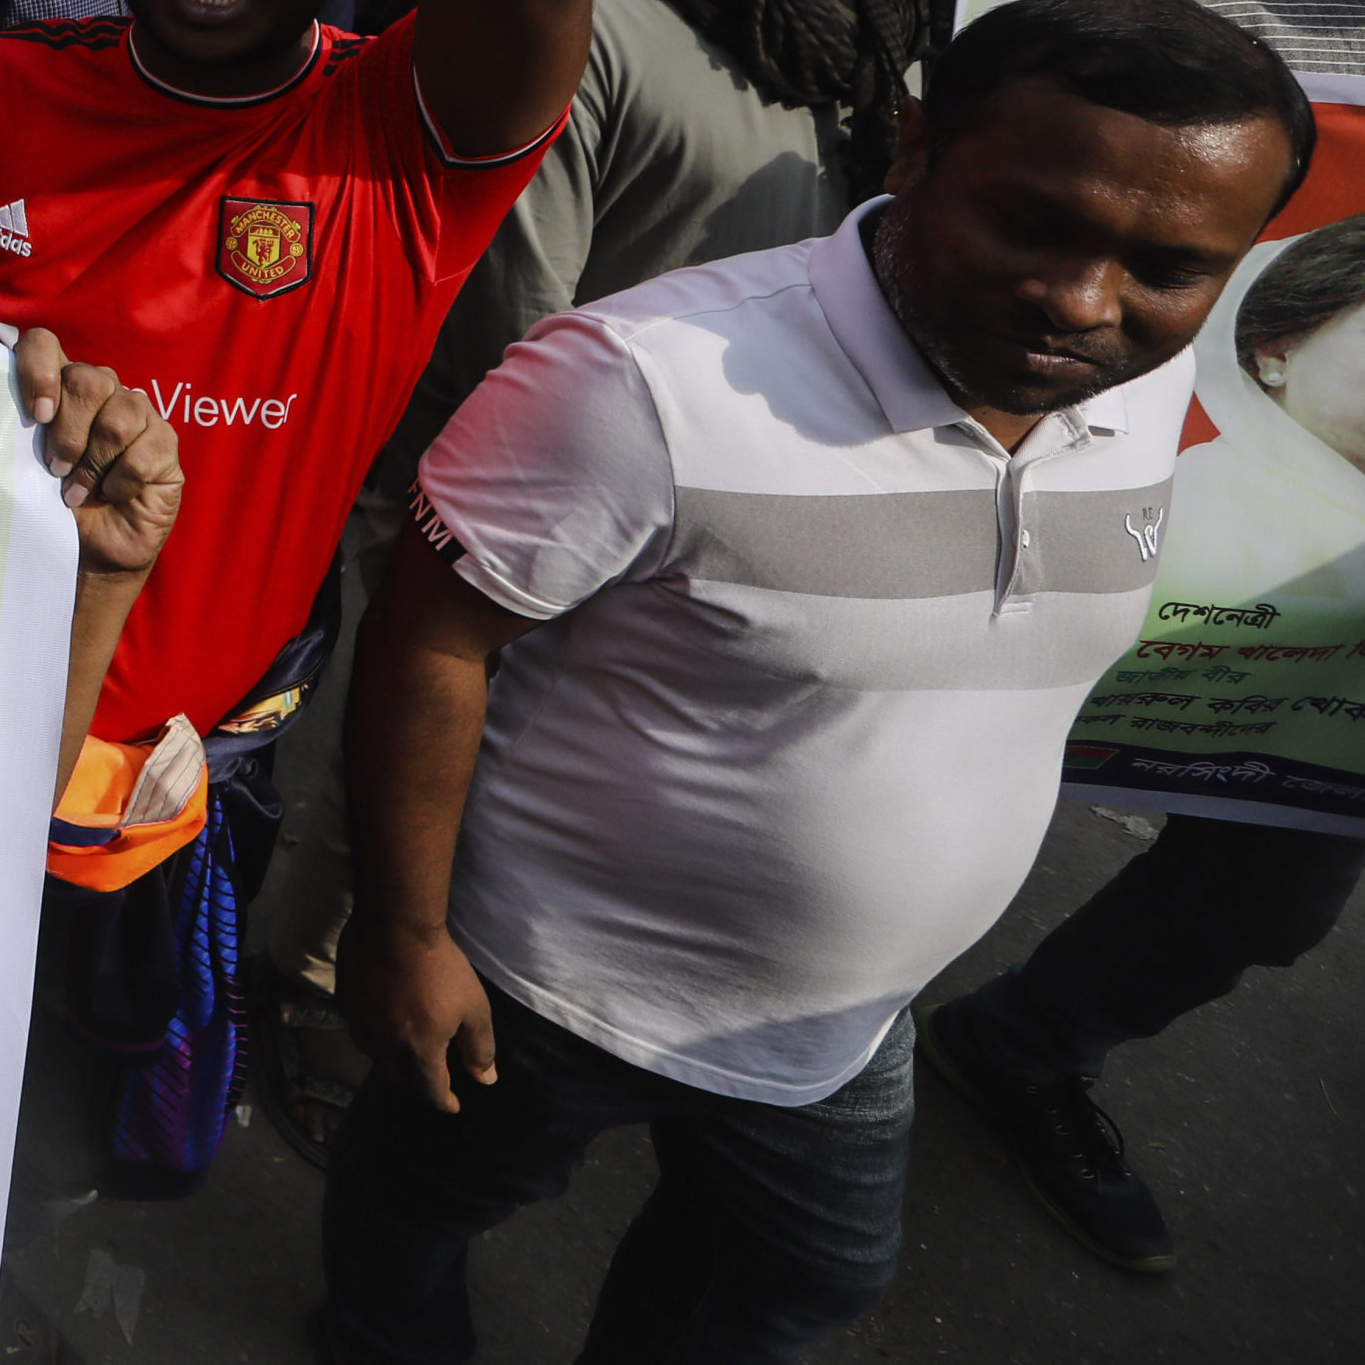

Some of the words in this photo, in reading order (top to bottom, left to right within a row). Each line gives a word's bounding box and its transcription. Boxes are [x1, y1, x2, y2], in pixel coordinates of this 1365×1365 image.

[235, 210, 296, 239] MANCHESTER
[241, 261, 285, 279] UNITED
[1158, 601, 1282, 630] দেশনেত্রী
[1137, 639, 1231, 663] বেগম
[1237, 643, 1345, 664] খালেদা
[1202, 664, 1254, 686] বীর
[1207, 695, 1290, 717] কবির
[1291, 695, 1365, 724] খোক
[1130, 715, 1277, 738] রাজবন্দীদের
[1130, 757, 1278, 784] নরসিংদী
[1281, 774, 1365, 801] জেল
